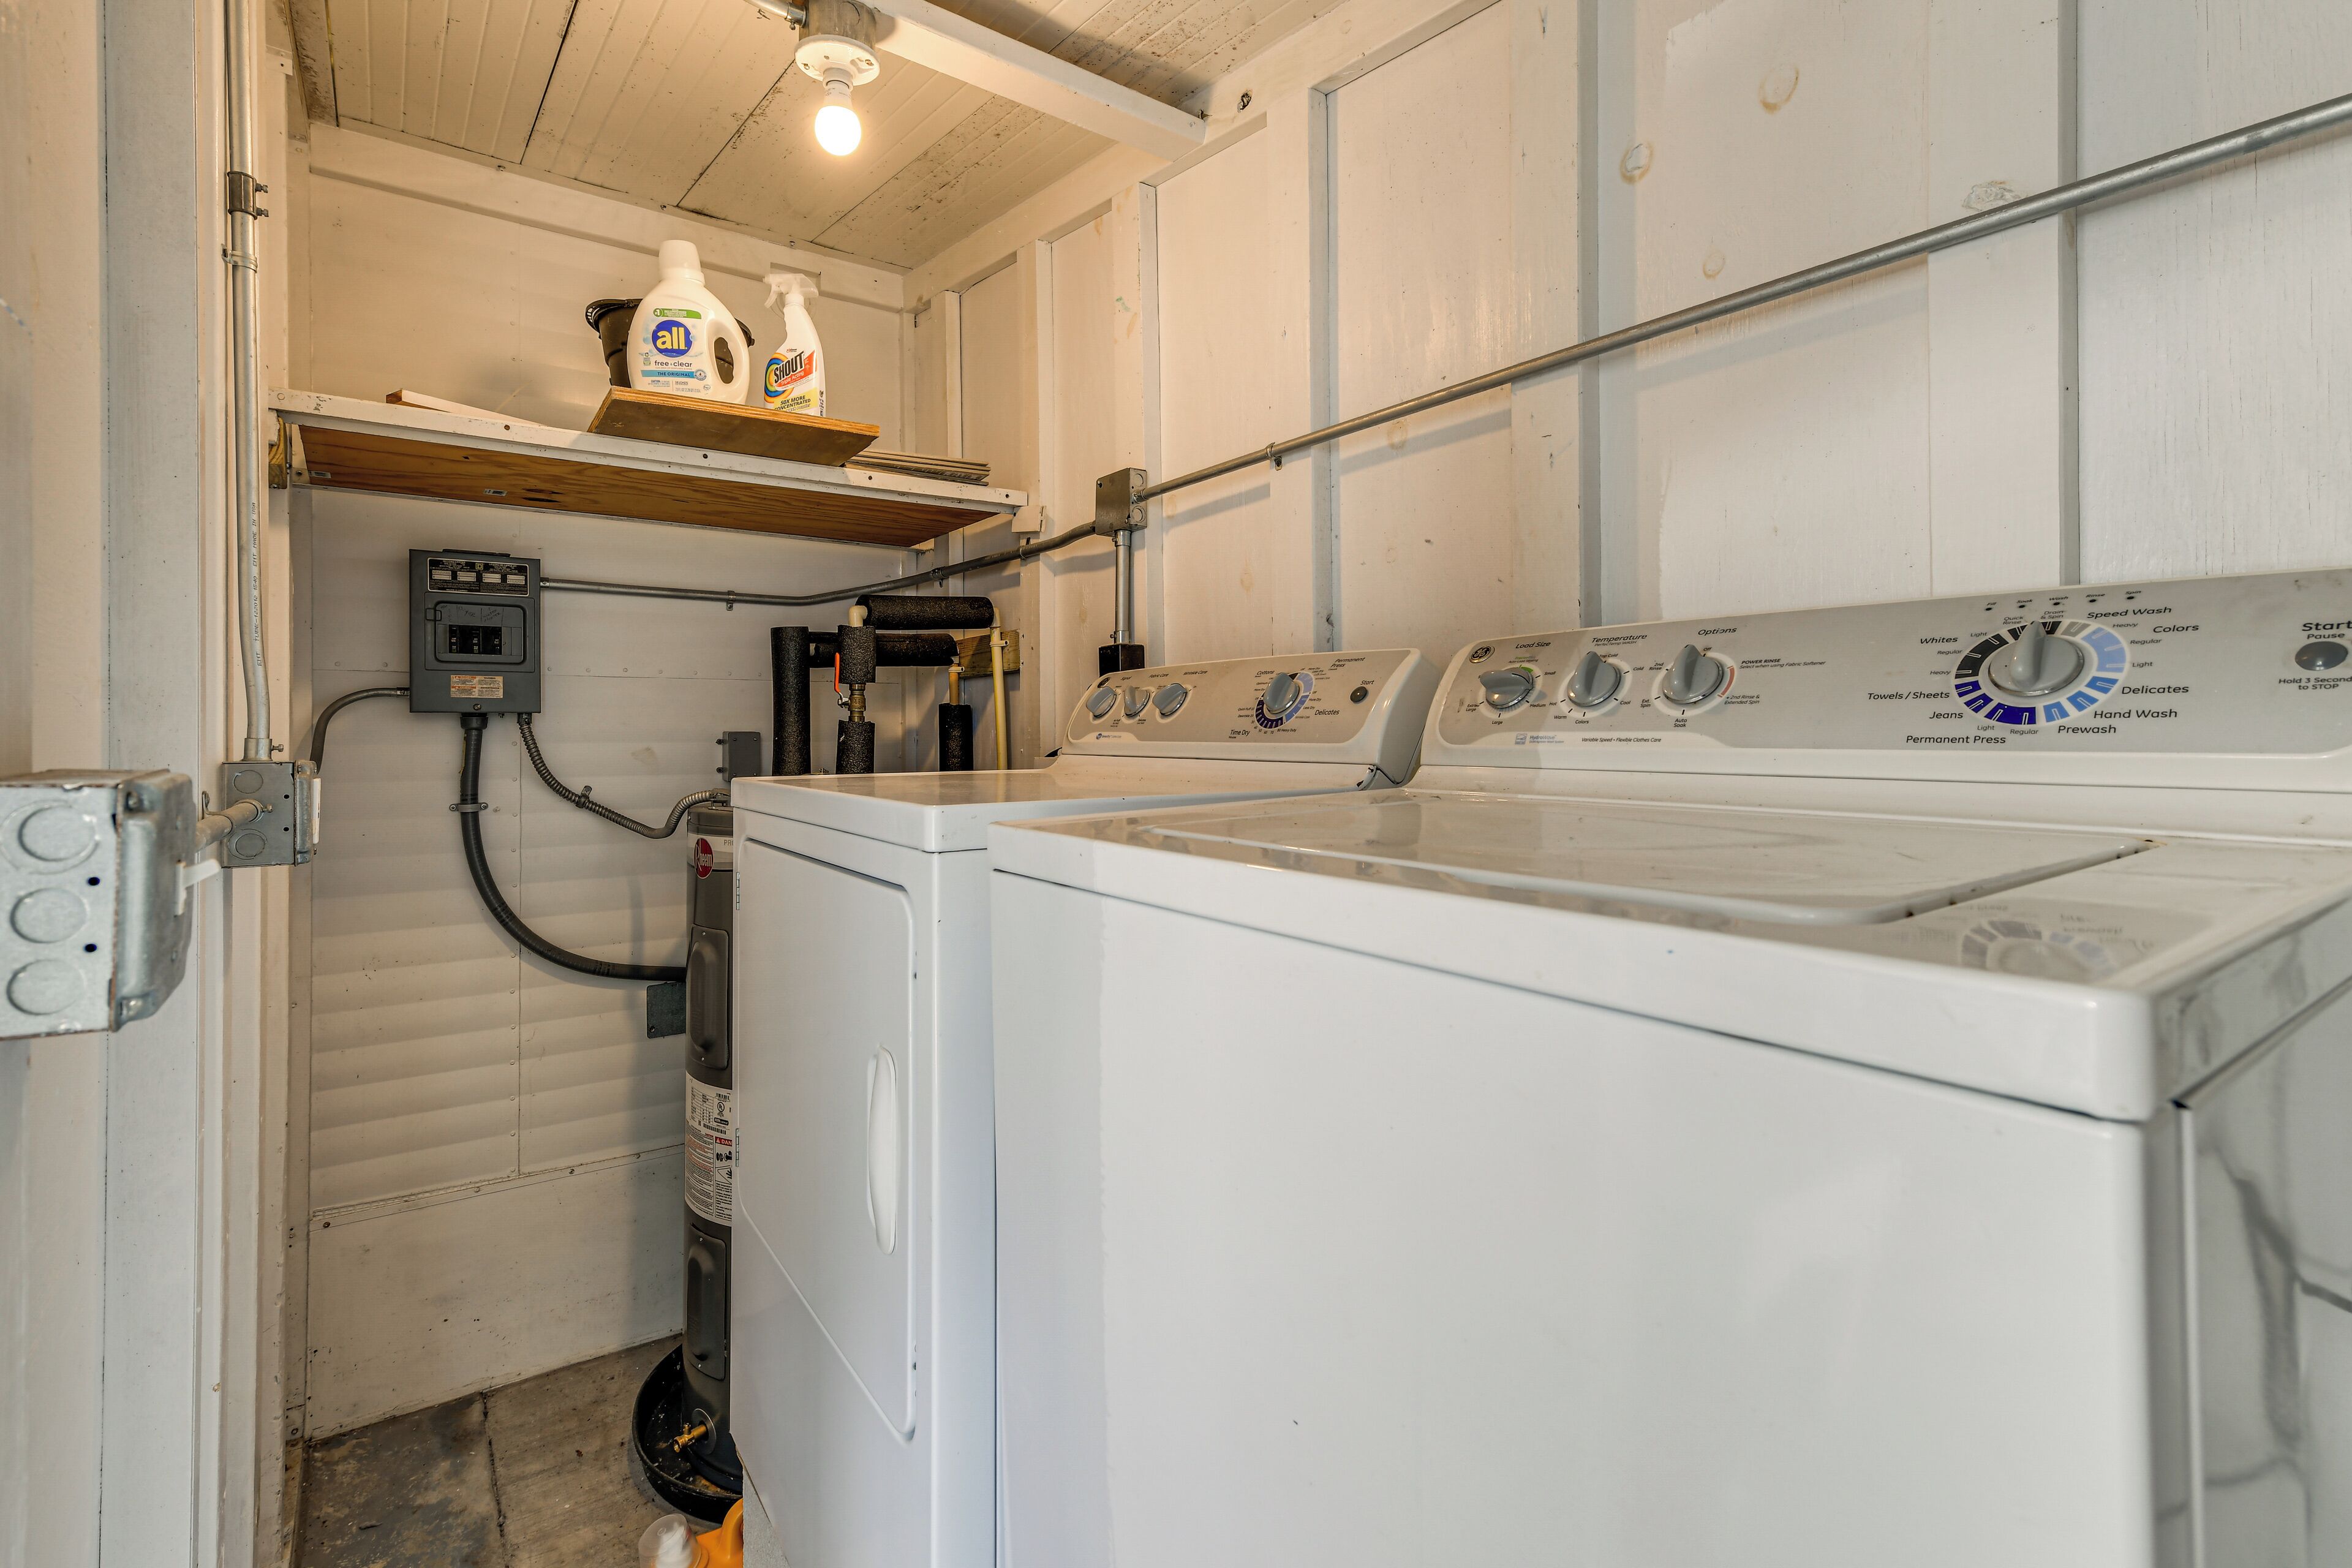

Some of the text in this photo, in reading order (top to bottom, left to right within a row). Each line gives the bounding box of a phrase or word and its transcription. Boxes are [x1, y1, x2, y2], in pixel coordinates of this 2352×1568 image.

[656, 326, 685, 350] all
[774, 350, 804, 383] SHOUT
[2087, 606, 2172, 619] Speed Wash
[2152, 624, 2200, 633] Colors
[2302, 620, 2352, 631] Start
[1698, 627, 1737, 637] Options
[1592, 635, 1647, 643] Temperature
[1920, 636, 1958, 644] Whites
[1912, 691, 1950, 699] Sheets
[2121, 685, 2190, 695] Delicates
[2094, 709, 2179, 719] Hand Wash
[2057, 725, 2117, 734] Prewash
[1905, 735, 2007, 744] Permanent Press
[695, 839, 712, 872] Rheem
